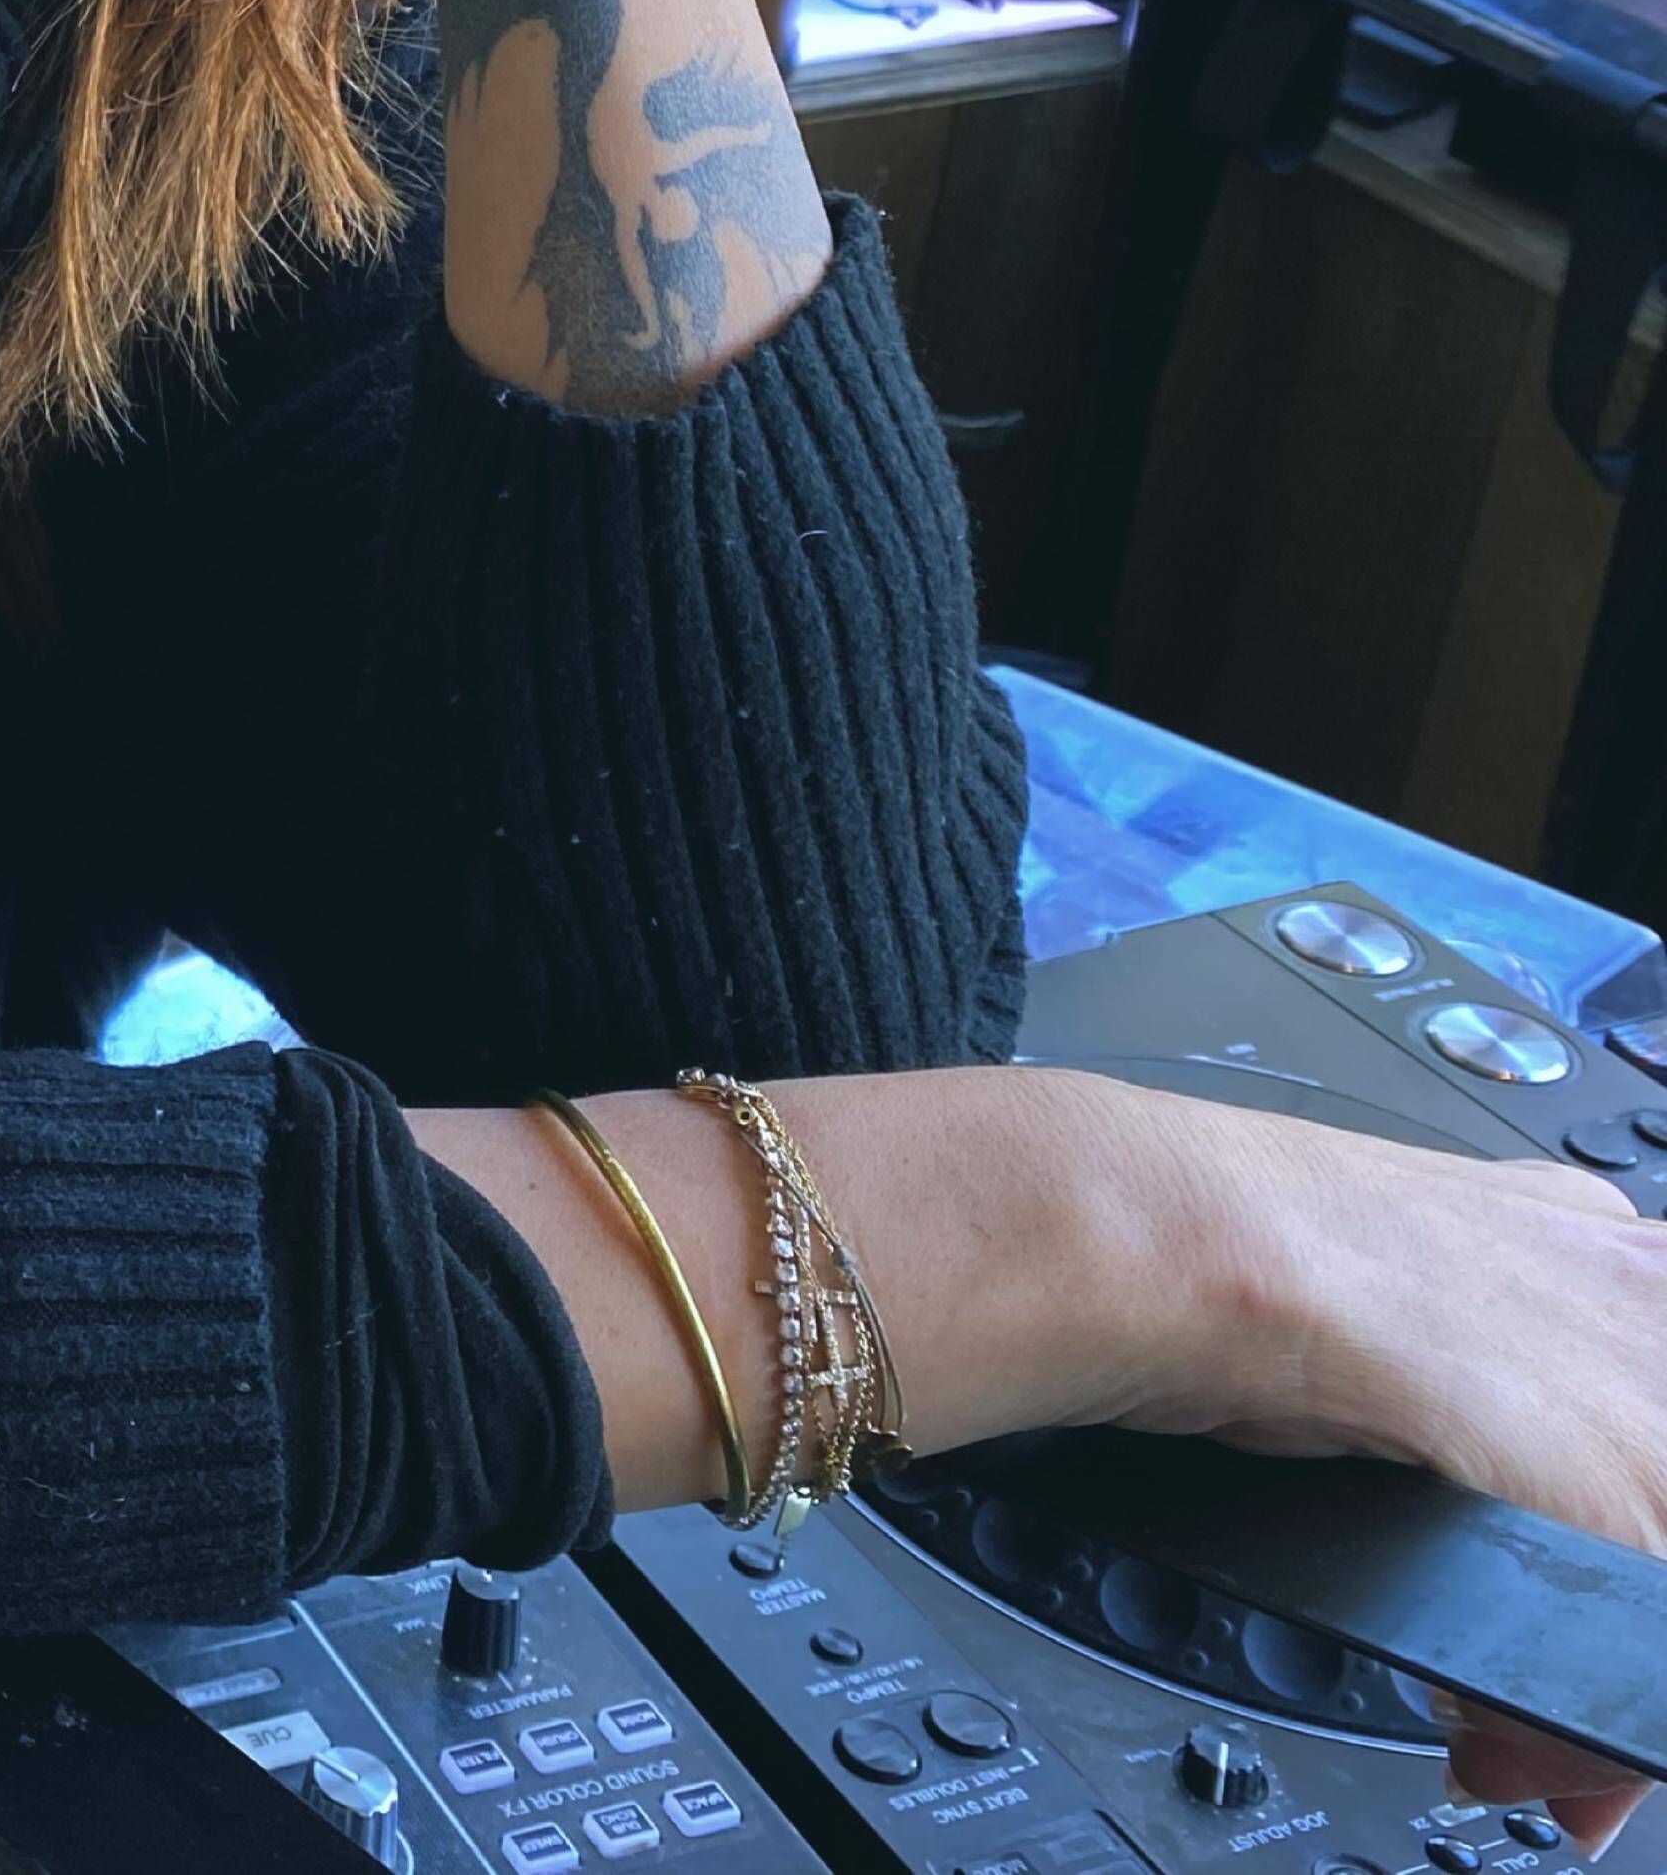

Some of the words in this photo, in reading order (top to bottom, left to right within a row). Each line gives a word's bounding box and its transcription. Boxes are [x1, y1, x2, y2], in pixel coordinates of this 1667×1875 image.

[467, 1685, 574, 1721] PARAMETER
[846, 1680, 909, 1706] TEMPO
[245, 1725, 293, 1749] CUE
[605, 1758, 681, 1791] SOUND
[495, 1797, 533, 1819] FX
[532, 1778, 606, 1817] COLOR
[888, 1779, 969, 1812] DOUBLES
[981, 1786, 1030, 1812] BEAT
[931, 1799, 984, 1825] SYNC
[1290, 1808, 1329, 1836] JOG
[1226, 1823, 1292, 1855] ADJUST
[1490, 1851, 1540, 1875] CALL
